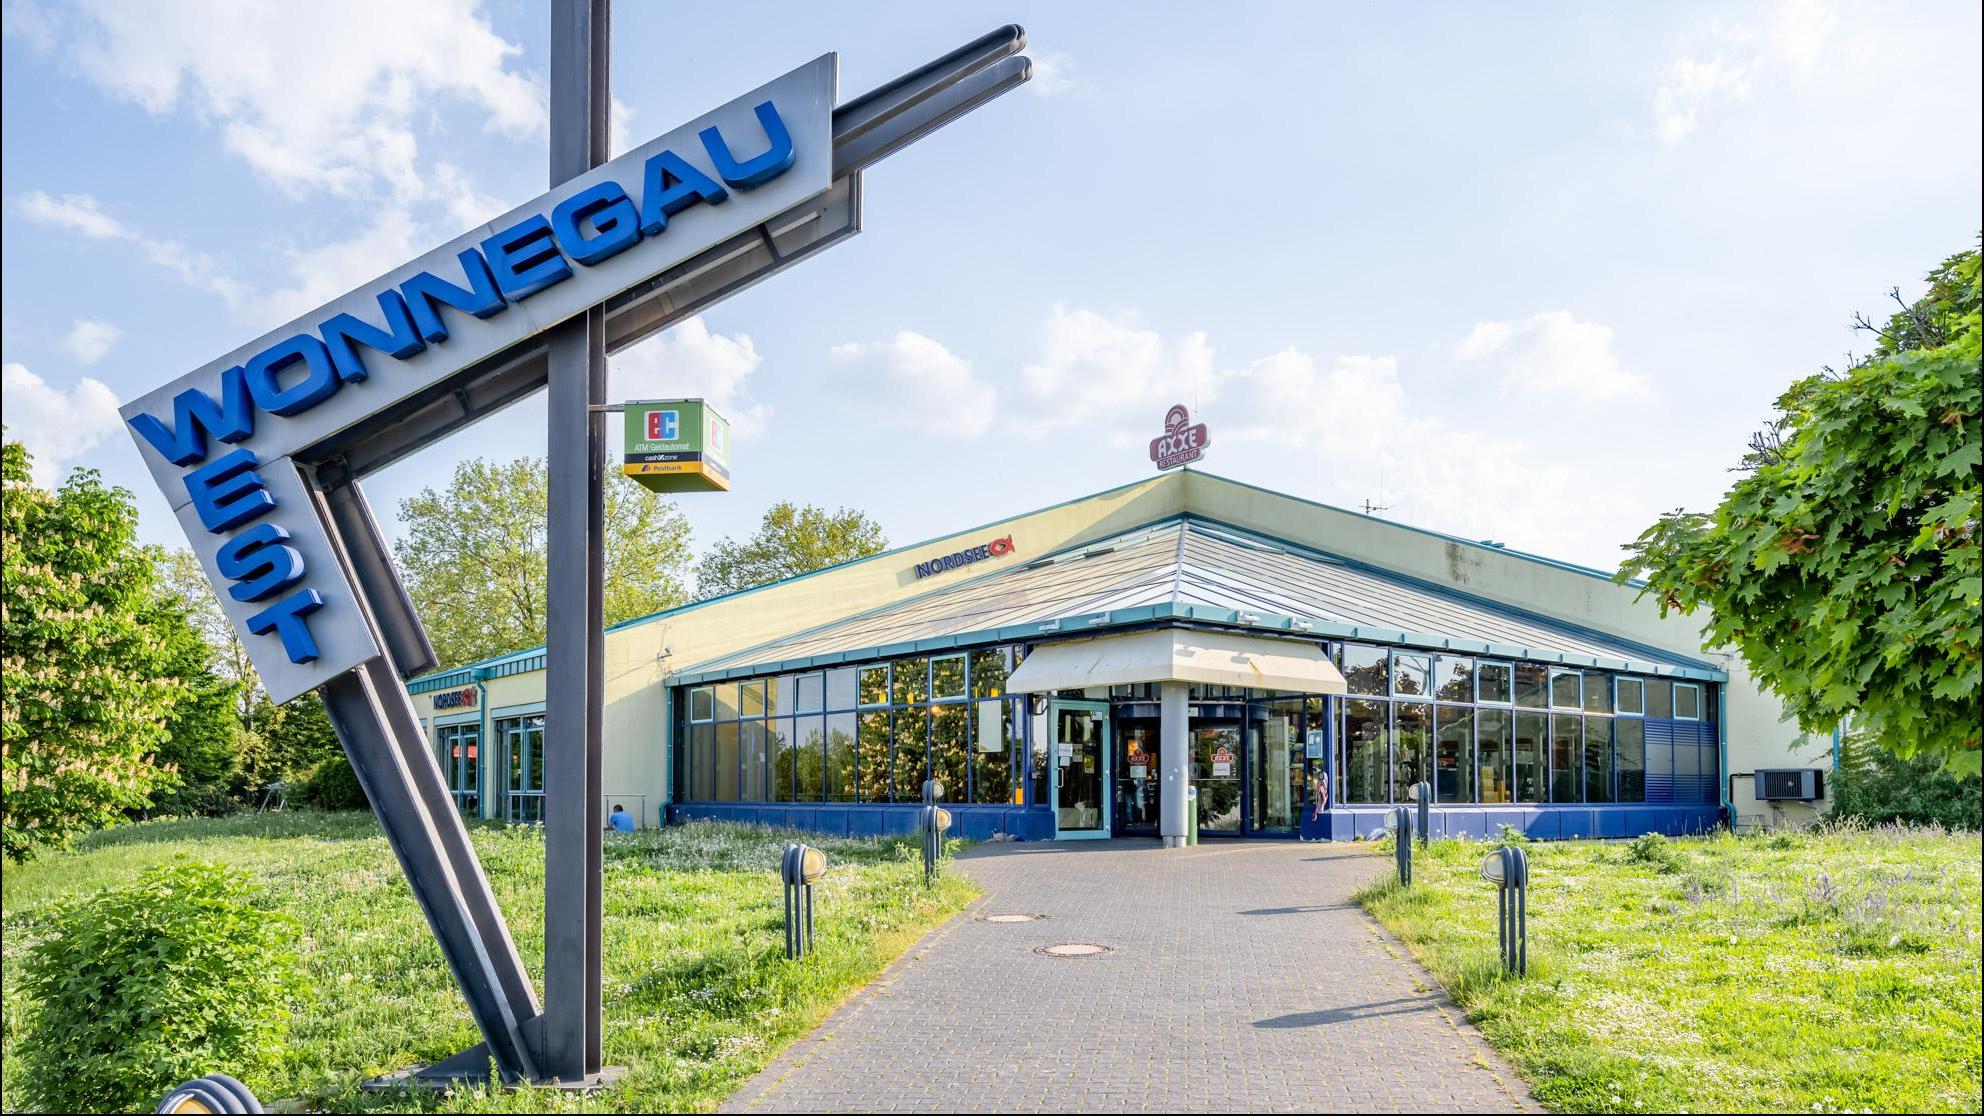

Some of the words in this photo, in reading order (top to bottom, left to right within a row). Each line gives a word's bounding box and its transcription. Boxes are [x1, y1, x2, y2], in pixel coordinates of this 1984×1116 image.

[129, 99, 795, 467] WONNEGAU
[634, 443, 649, 452] ATM
[1157, 429, 1198, 458] AXXE
[653, 464, 682, 472] Postbank
[1159, 450, 1198, 467] RESTAURANT
[183, 448, 325, 665] WEST
[915, 544, 990, 579] NORDSEE
